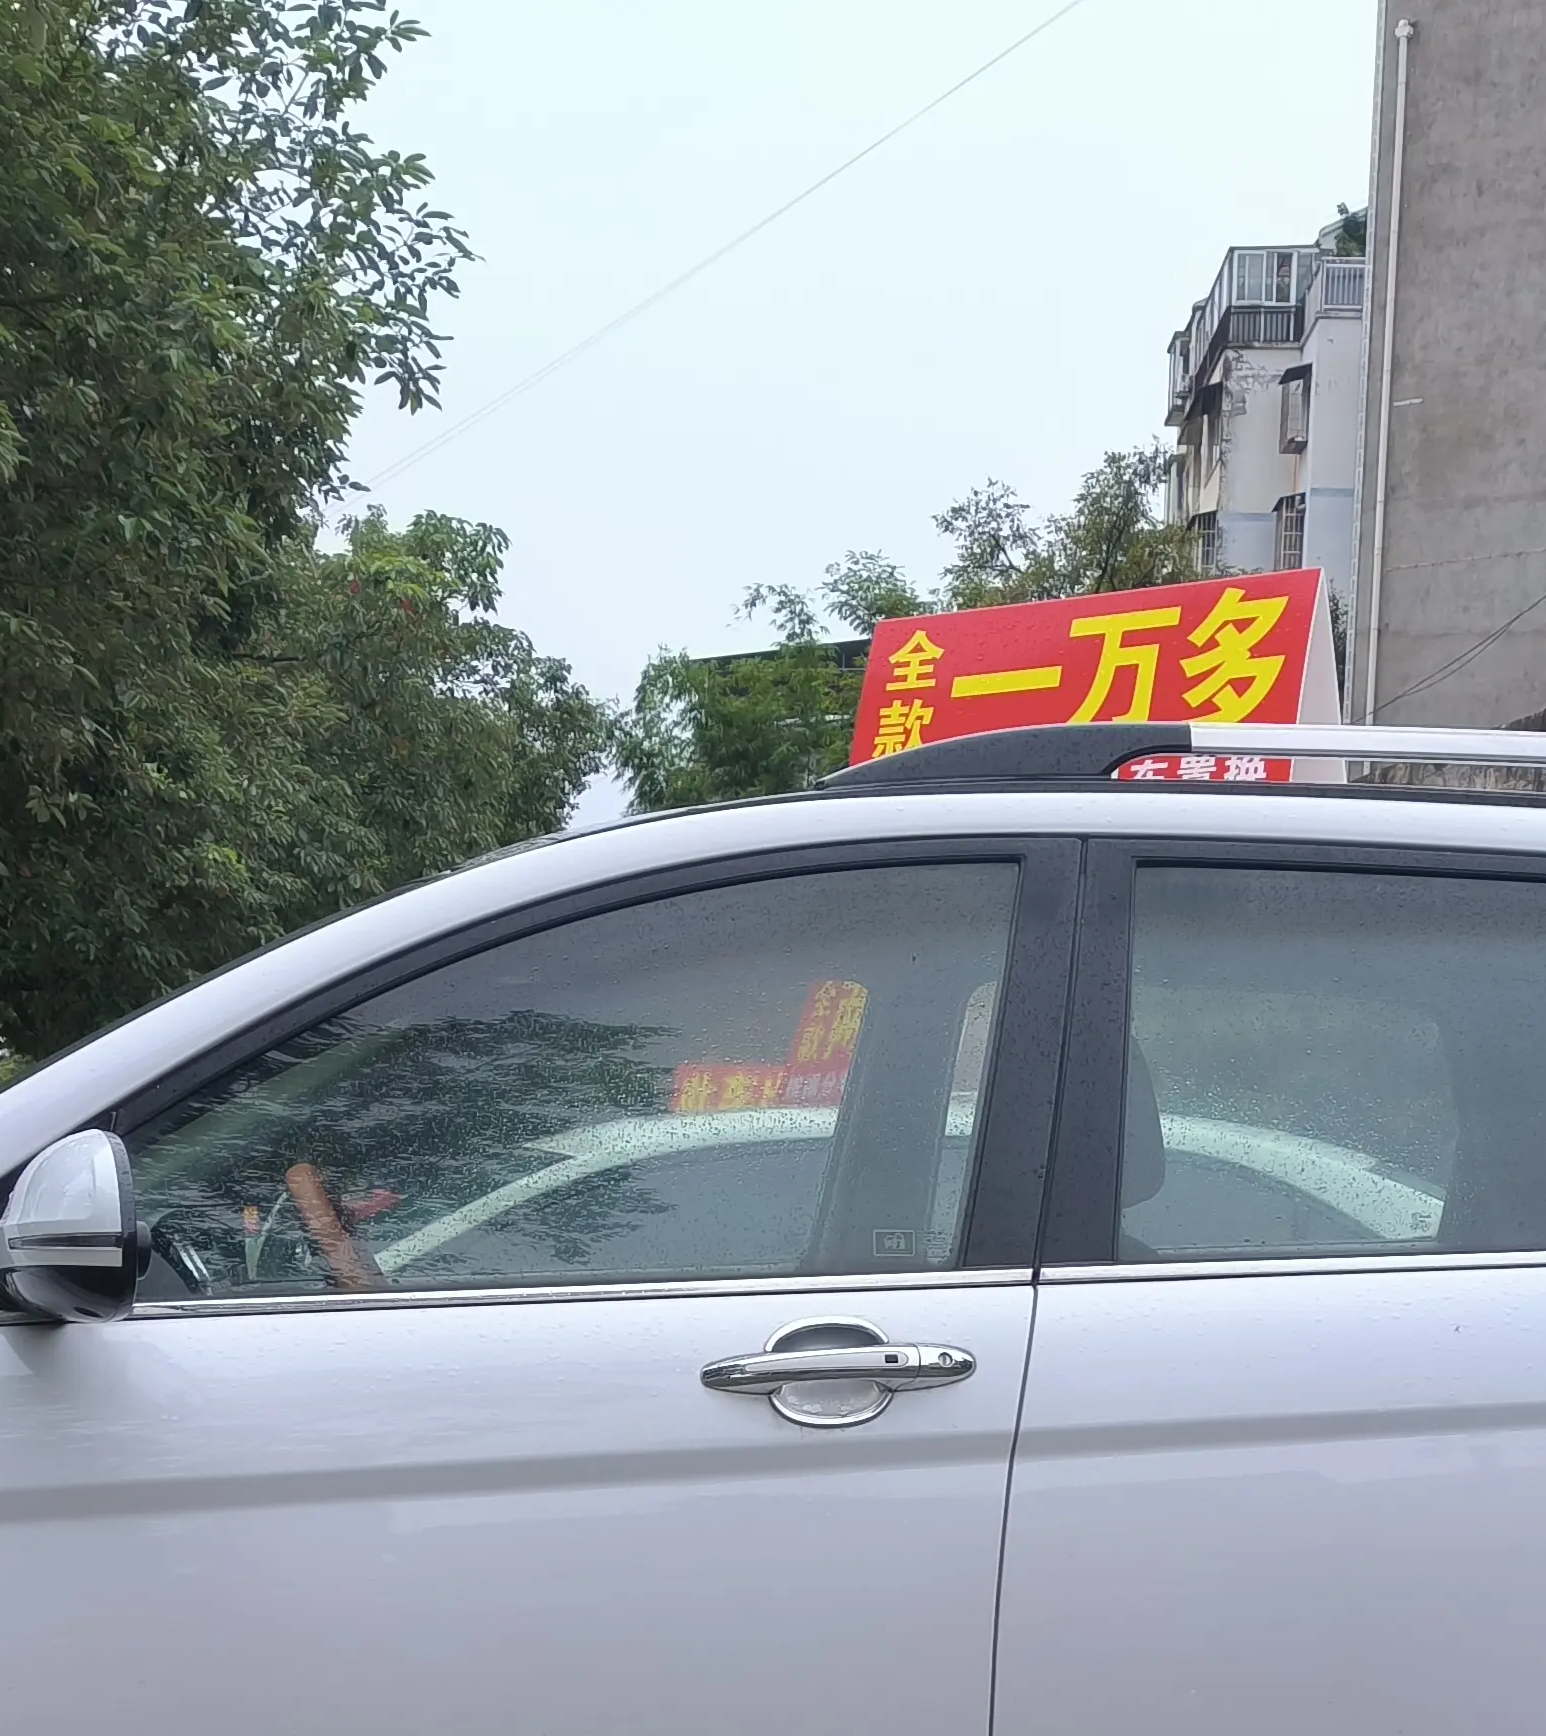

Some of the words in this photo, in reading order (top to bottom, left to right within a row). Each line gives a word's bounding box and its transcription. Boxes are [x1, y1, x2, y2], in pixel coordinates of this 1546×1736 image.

[871, 629, 945, 757] 全款
[950, 587, 1290, 723] 一万多
